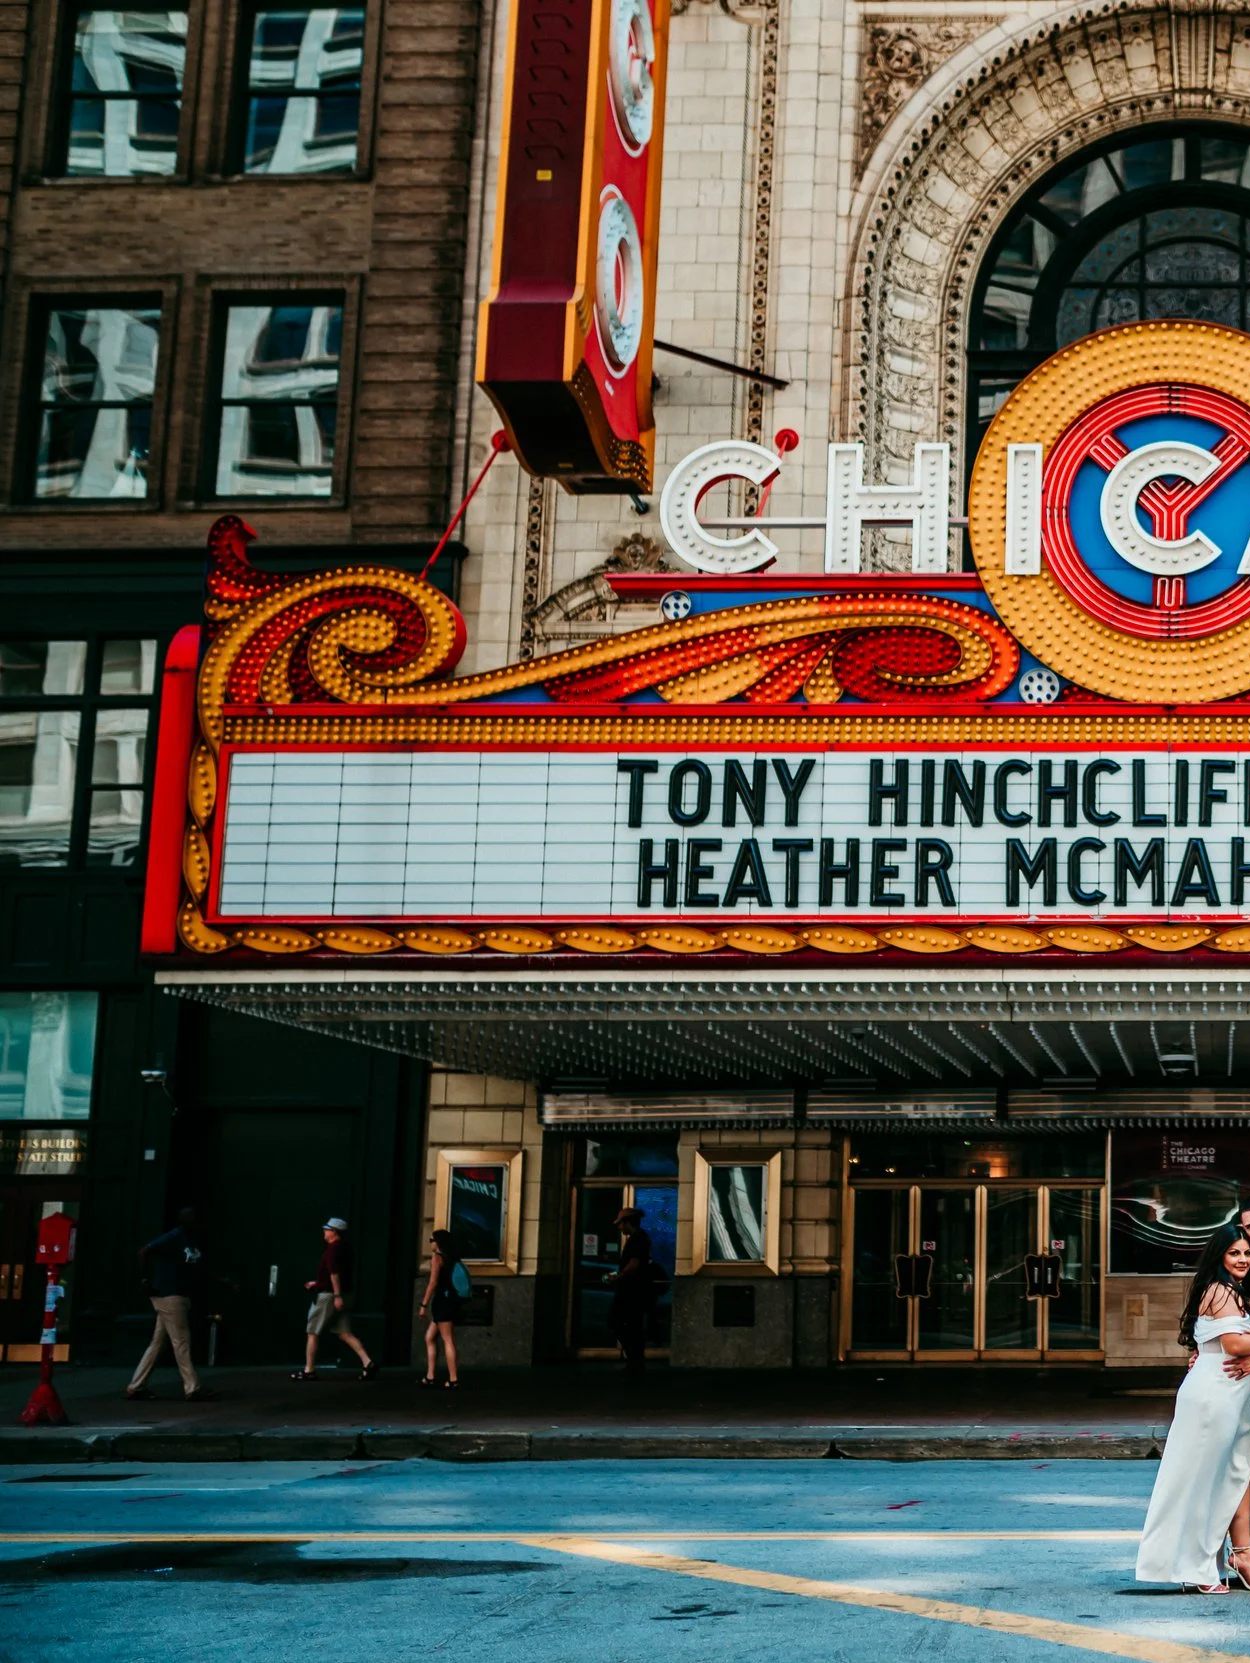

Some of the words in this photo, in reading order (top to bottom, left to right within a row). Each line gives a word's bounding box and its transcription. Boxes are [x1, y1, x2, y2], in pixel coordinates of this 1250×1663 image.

[616, 758, 816, 828] TONY
[636, 837, 957, 908] HEATHER
[1169, 1147, 1216, 1155] CHICAGO
[1170, 1155, 1216, 1164] THEATRE
